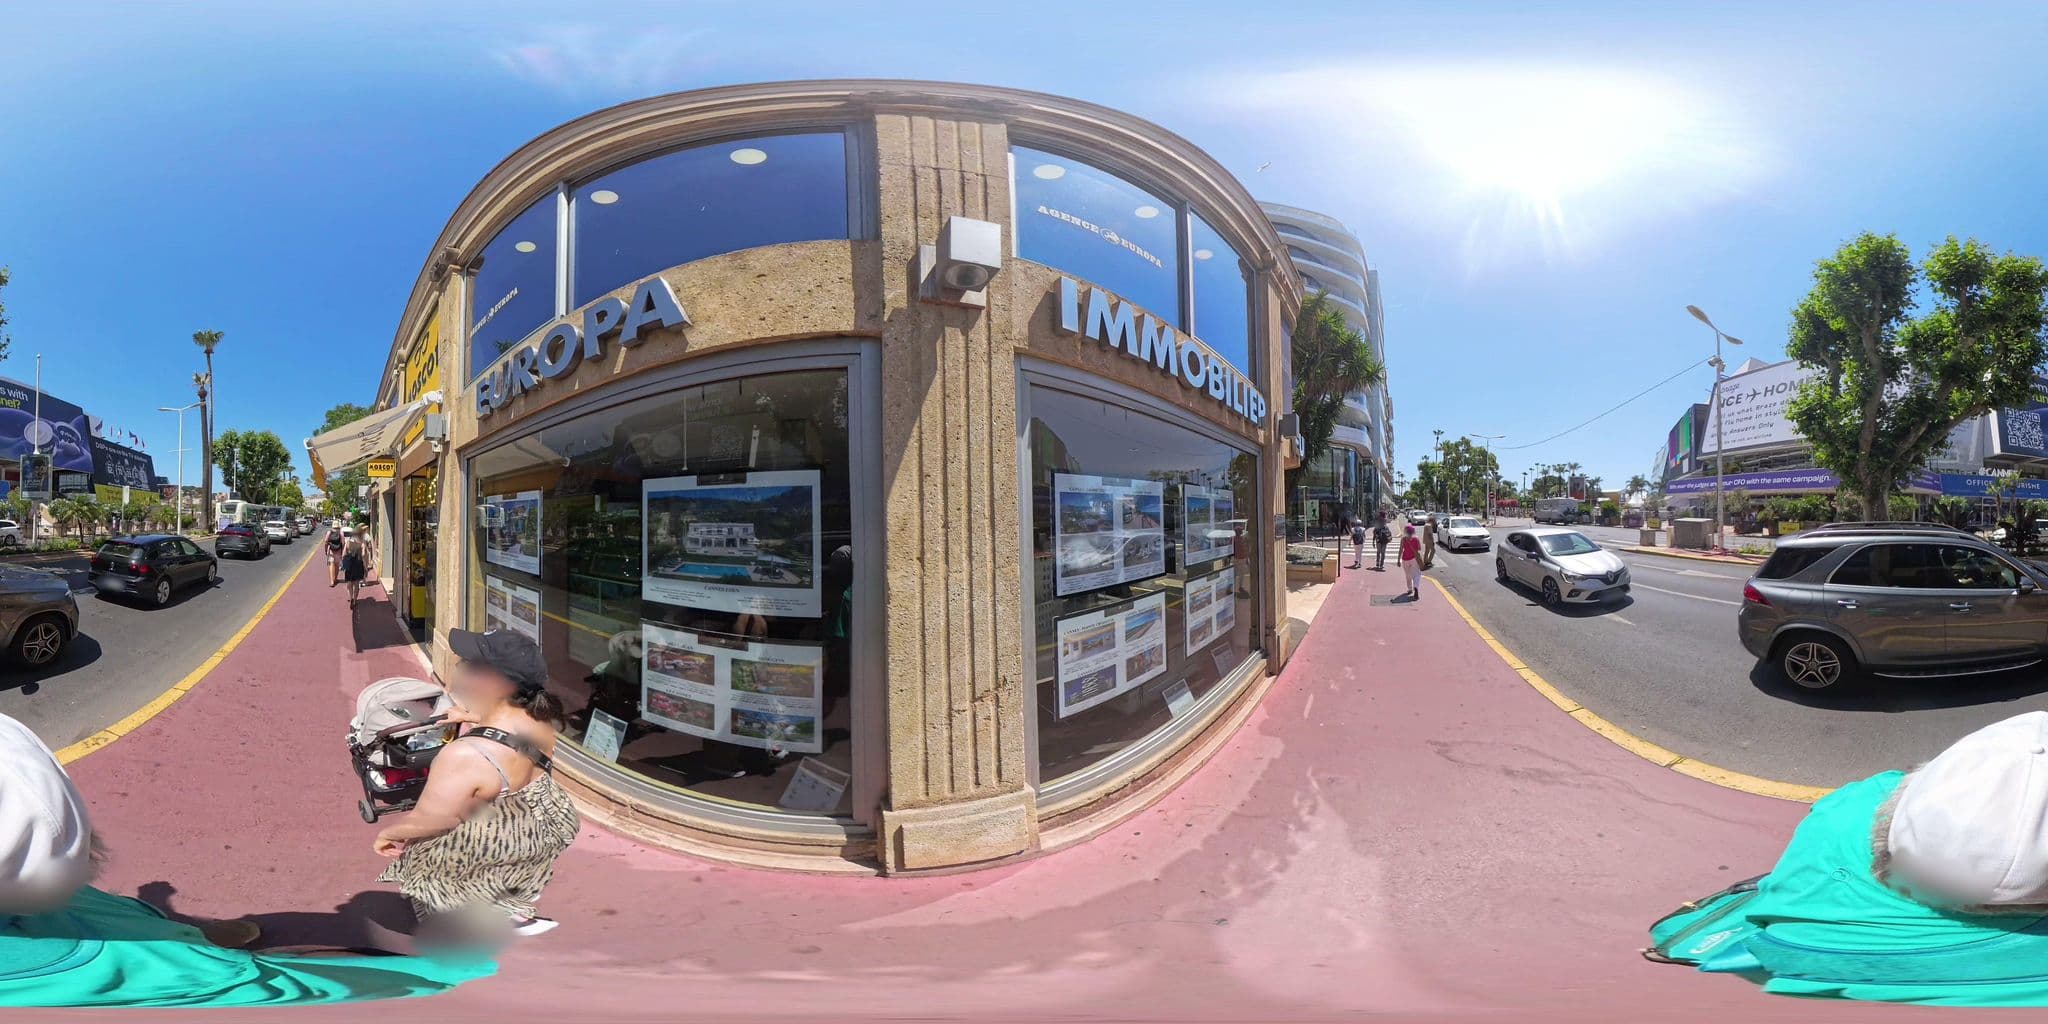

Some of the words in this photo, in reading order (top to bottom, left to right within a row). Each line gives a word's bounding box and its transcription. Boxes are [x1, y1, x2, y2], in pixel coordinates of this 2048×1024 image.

[1037, 205, 1100, 234] AGENCE
[1121, 237, 1163, 269] EUROPA
[494, 286, 519, 313] EUROPA
[476, 275, 692, 420] EUROPA
[7, 388, 29, 401] with
[1733, 478, 1746, 486] CFO
[1746, 477, 1760, 485] with
[1760, 475, 1772, 484] the
[1792, 474, 1832, 483] campaign.
